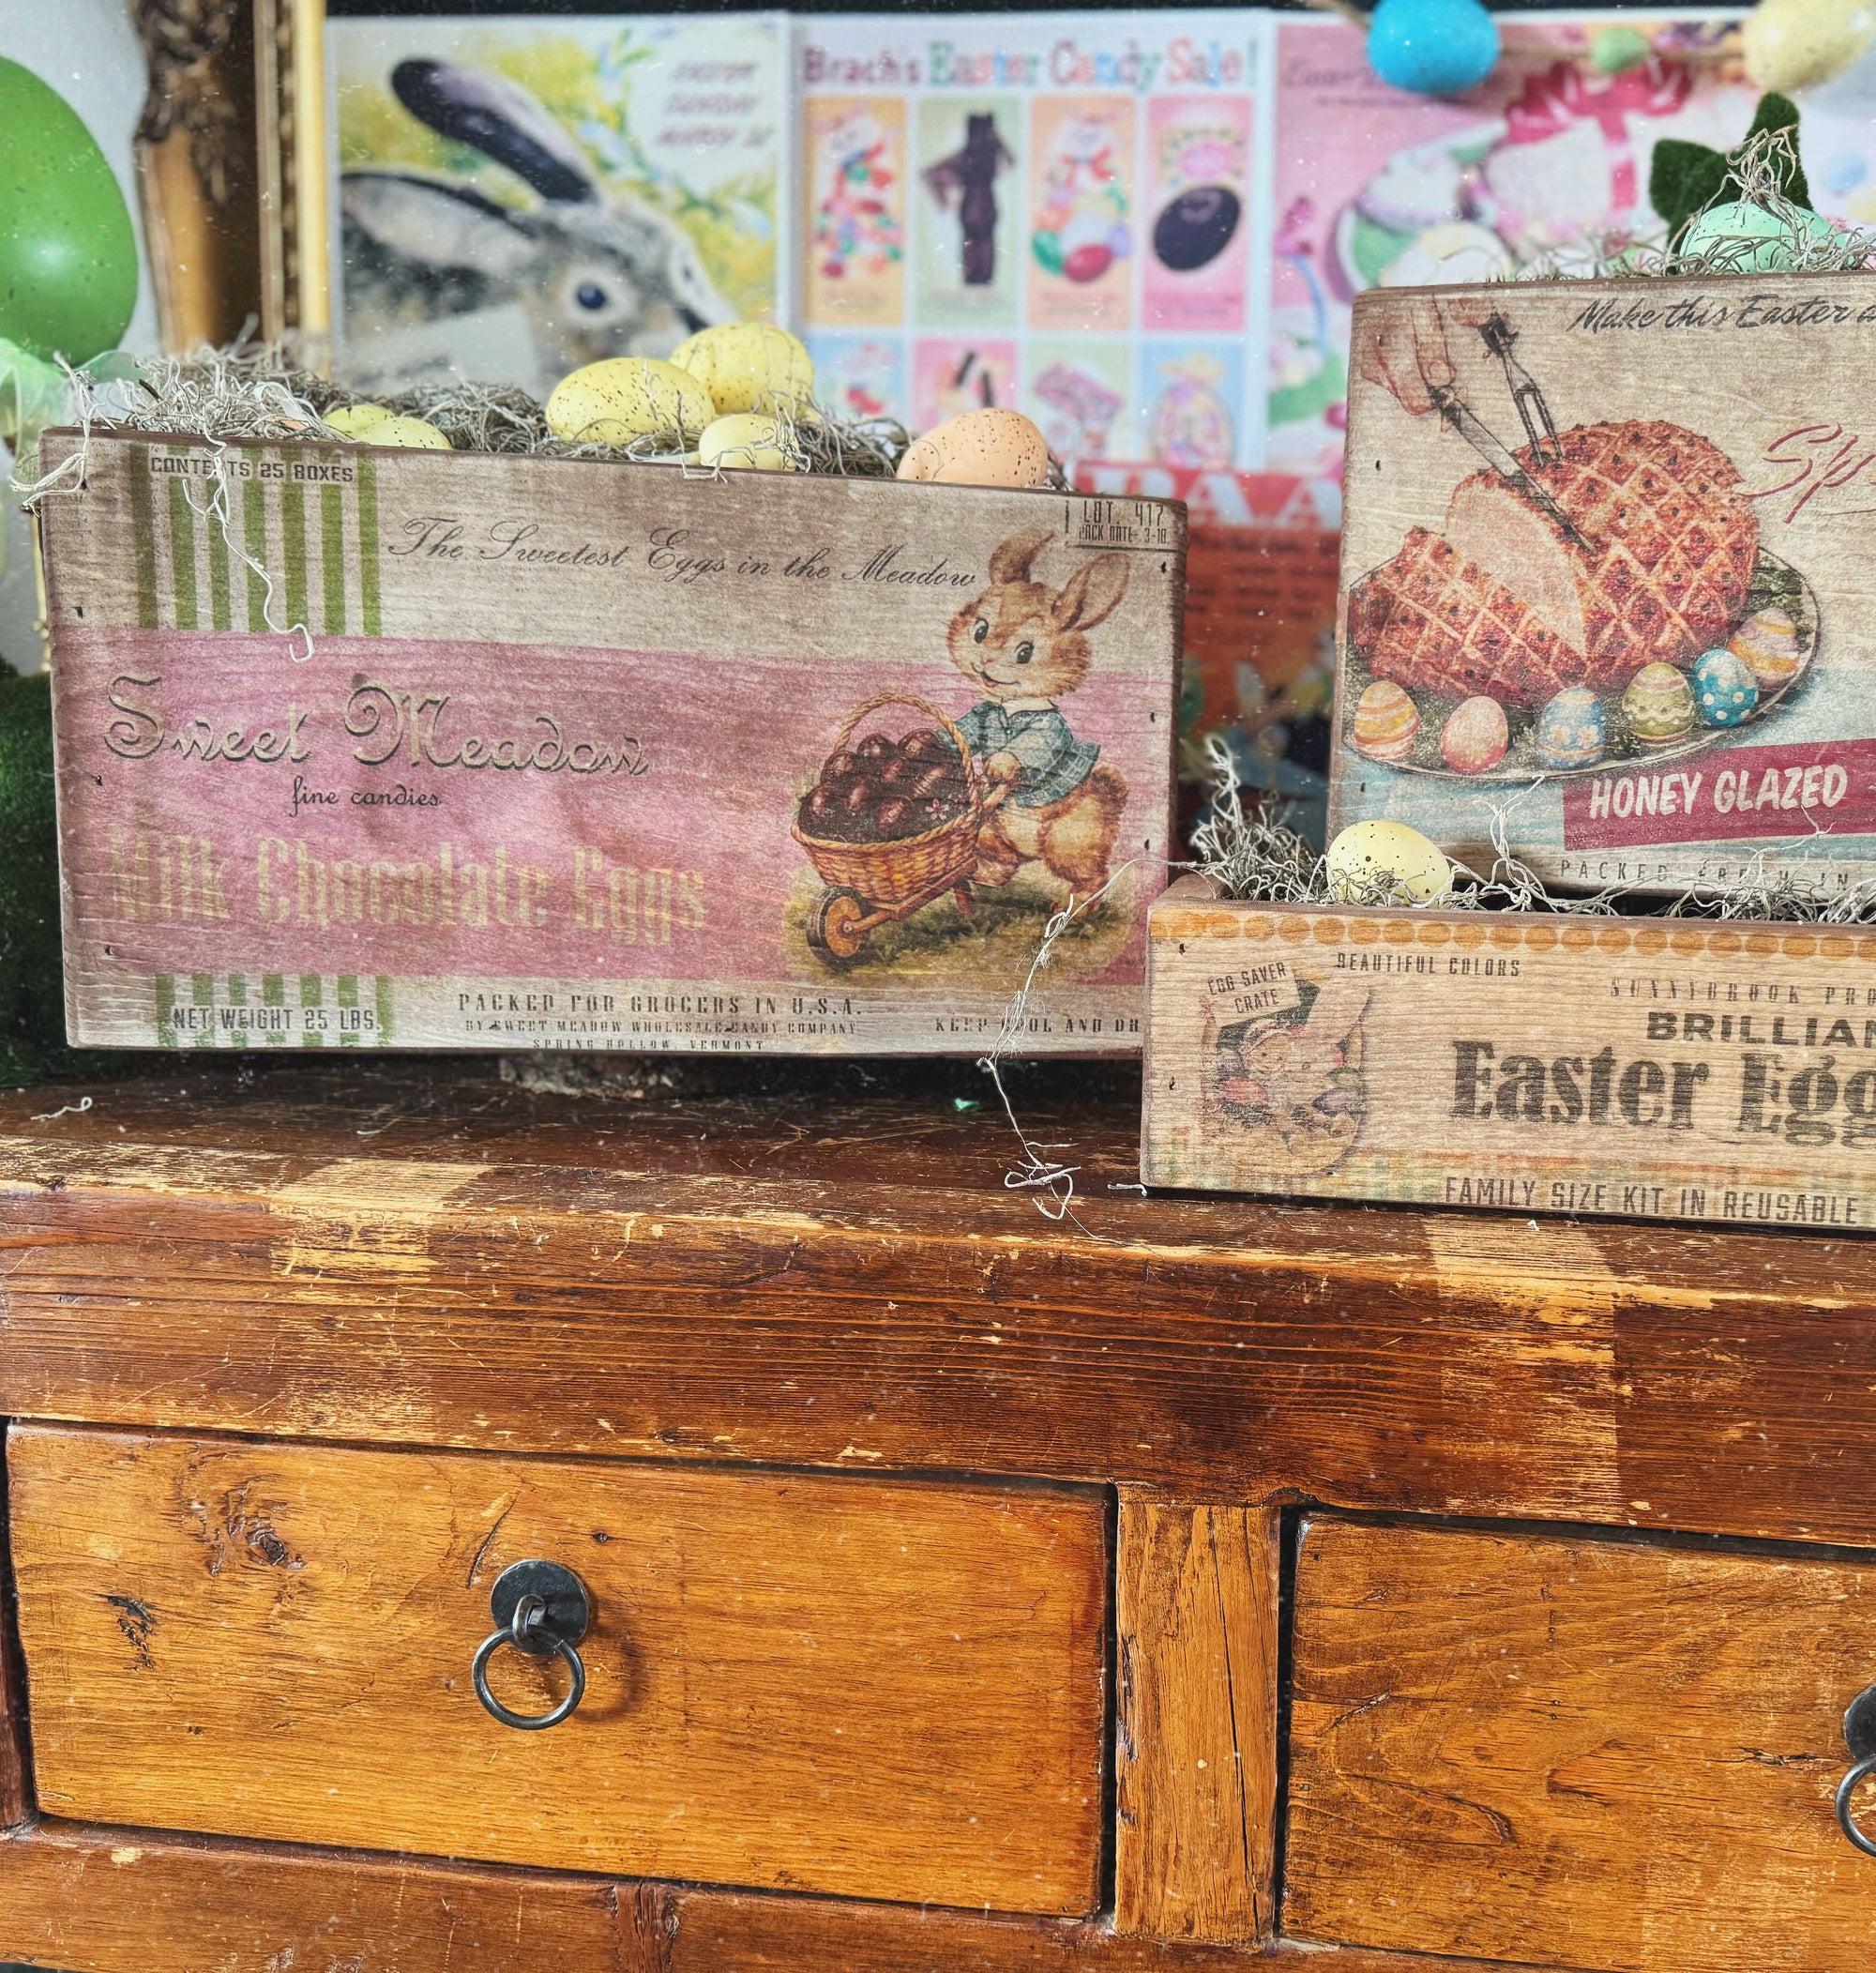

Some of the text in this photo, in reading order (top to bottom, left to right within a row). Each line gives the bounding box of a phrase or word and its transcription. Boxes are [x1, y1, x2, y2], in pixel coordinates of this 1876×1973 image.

[929, 40, 1040, 86] Easter
[1048, 38, 1161, 93] Candy
[1566, 296, 1664, 334] Make
[1664, 296, 1736, 330] this
[1737, 294, 1857, 328] Easter
[151, 457, 354, 482] CONTETS 25 BOXES
[1083, 499, 1163, 527] LOT. 417
[1079, 524, 1104, 540] PACK
[388, 516, 976, 587] The Sweetest Eggs in the Meadow
[103, 675, 651, 775] Sweet Meadow
[289, 776, 442, 818] fine candies
[1589, 764, 1848, 819] HONEY GLAZED
[1560, 859, 1669, 882] PACKED
[258, 837, 552, 931] Chocolate
[571, 845, 707, 946] Eggs
[1338, 951, 1520, 977] BEAUTIFUL COLORS
[1208, 962, 1287, 995] EGG SAVER
[458, 994, 862, 1016] PACKED FOR GROCERS IN U.S.A.
[1234, 989, 1279, 1013] CRATE
[173, 1008, 381, 1031] NET WEIGHT 25 LBS.
[465, 1020, 484, 1032] BY
[557, 1021, 622, 1033] MEADOW
[631, 1021, 723, 1034] WHOLESALE
[788, 1023, 856, 1035] COMPANY
[1065, 1018, 1102, 1033] AND
[533, 1039, 594, 1050] SPRING
[690, 1040, 764, 1051] VERMONT
[1451, 1040, 1710, 1130] Easter
[1445, 1176, 1860, 1224] FAMILY SIZE KIT IN REUSABLE
